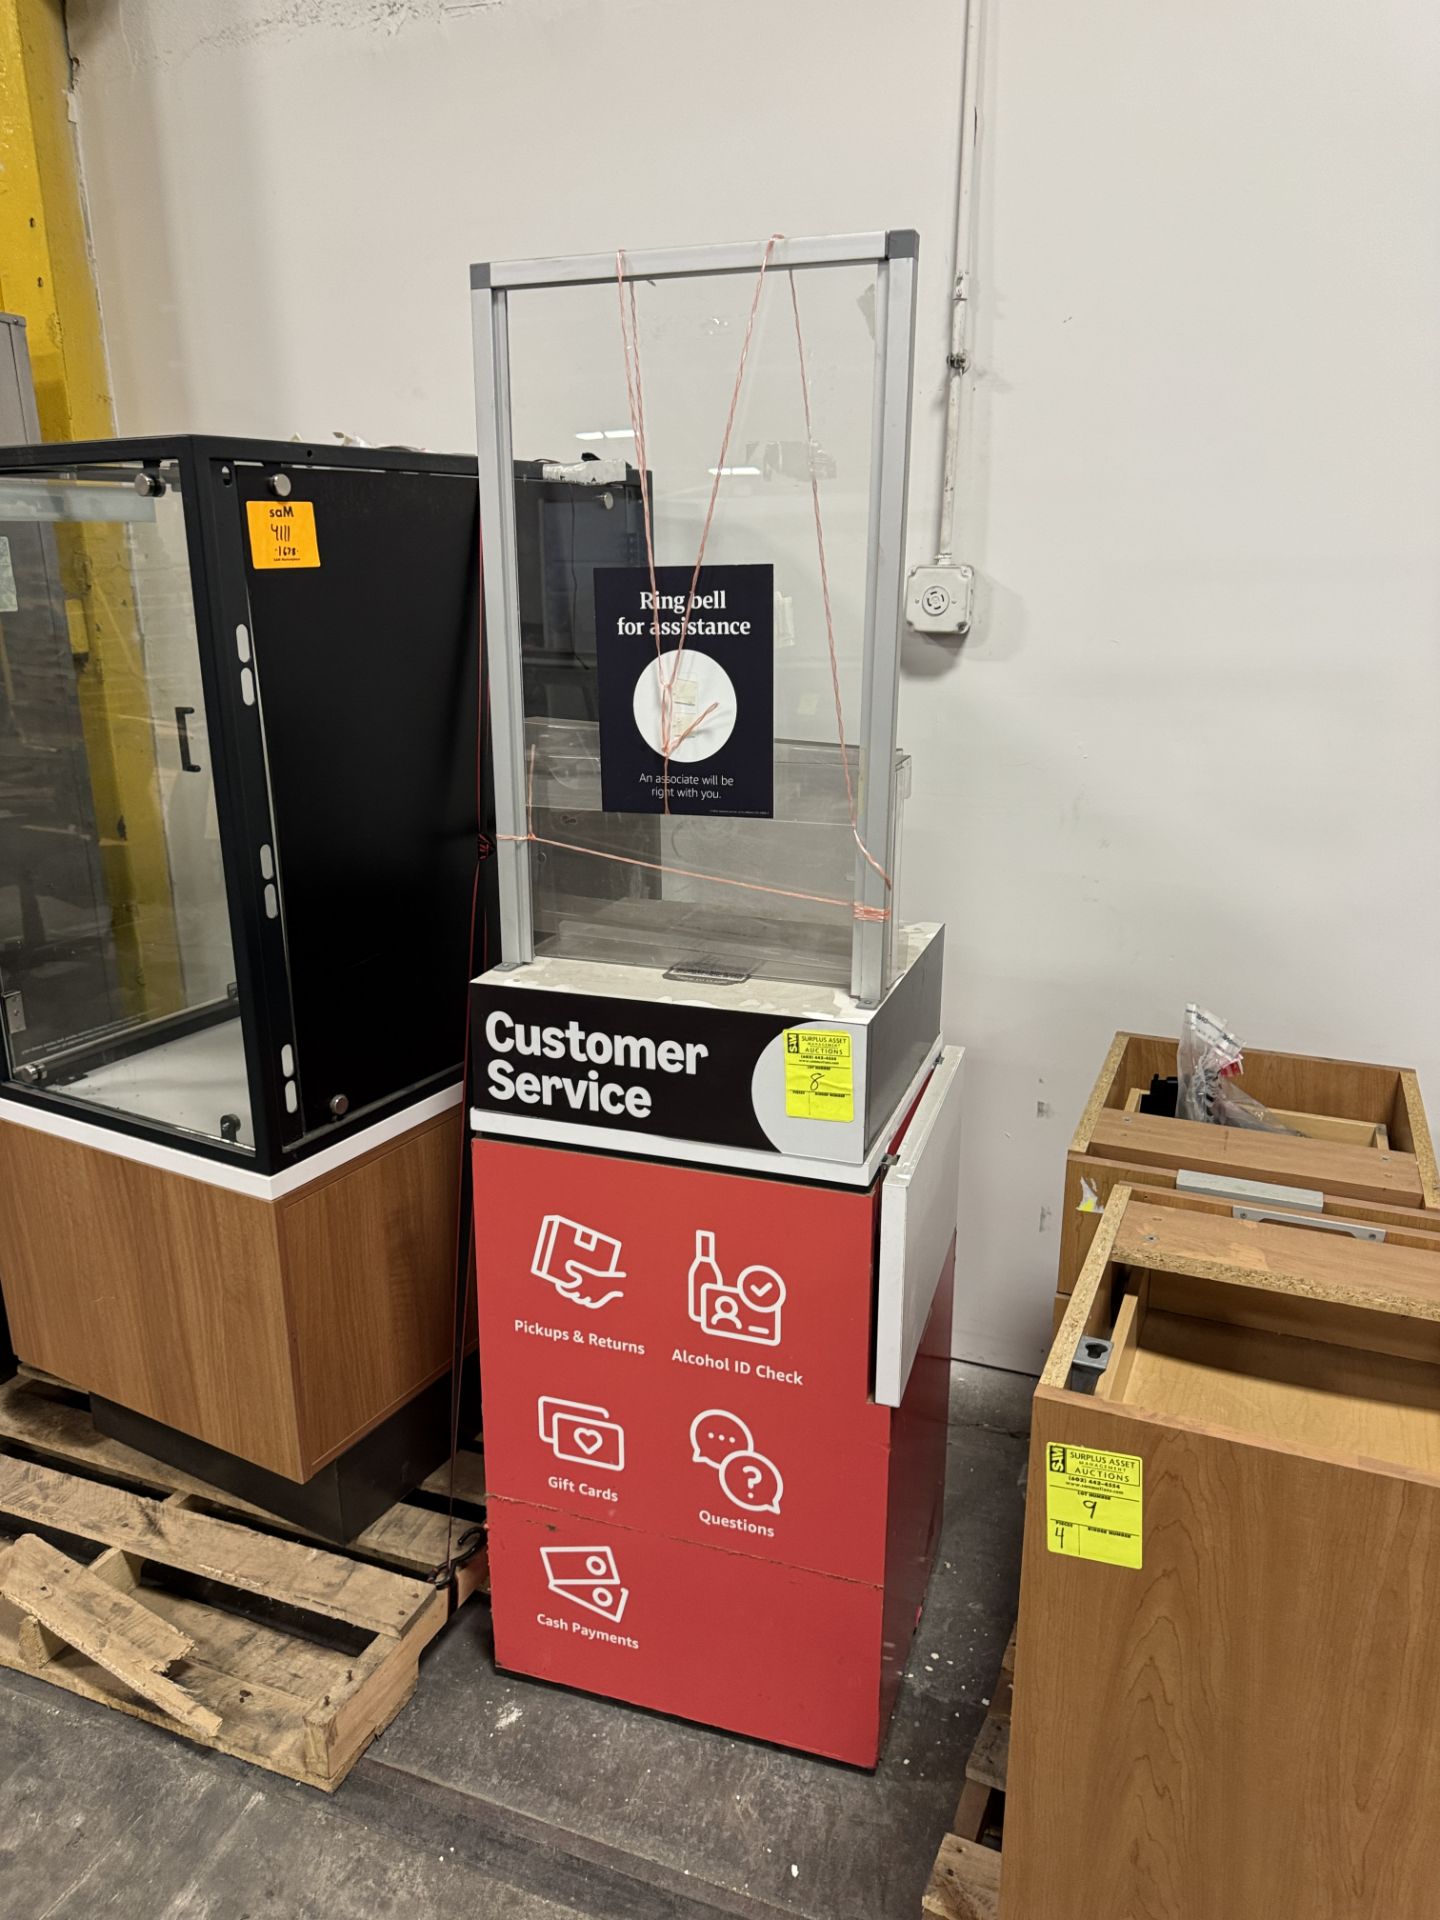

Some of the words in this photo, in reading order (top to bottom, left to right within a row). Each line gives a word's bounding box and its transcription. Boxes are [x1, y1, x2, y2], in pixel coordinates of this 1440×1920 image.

[639, 591, 685, 614] Ring
[689, 590, 726, 609] bell
[617, 617, 645, 636] for
[649, 616, 751, 635] assistance
[639, 773, 653, 783] An
[655, 774, 699, 785] associate
[702, 775, 718, 786] will
[721, 775, 734, 786] be
[677, 788, 698, 798] with
[701, 790, 722, 801] you.
[485, 1010, 709, 1076] Customer
[801, 1035, 828, 1043] SURPLUS
[487, 1059, 652, 1120] Service
[810, 1072, 825, 1091] 8
[514, 1319, 569, 1343] Pickups
[573, 1330, 585, 1344] &
[588, 1332, 646, 1356] Returns
[671, 1348, 730, 1372] Alcohol
[734, 1360, 751, 1375] ID
[756, 1364, 804, 1386] Check
[1070, 1451, 1107, 1464] SURPLUS
[1109, 1457, 1135, 1469] ASSET
[1078, 1460, 1127, 1473] MANAGEMENT
[1075, 1467, 1130, 1483] AUCTIONS
[547, 1475, 576, 1492] Gift
[578, 1482, 619, 1502] Cards
[1082, 1500, 1098, 1519] 9
[699, 1509, 775, 1538] Questions
[1055, 1527, 1065, 1549] 4
[536, 1612, 569, 1632] Cash
[572, 1621, 639, 1650] Payments
